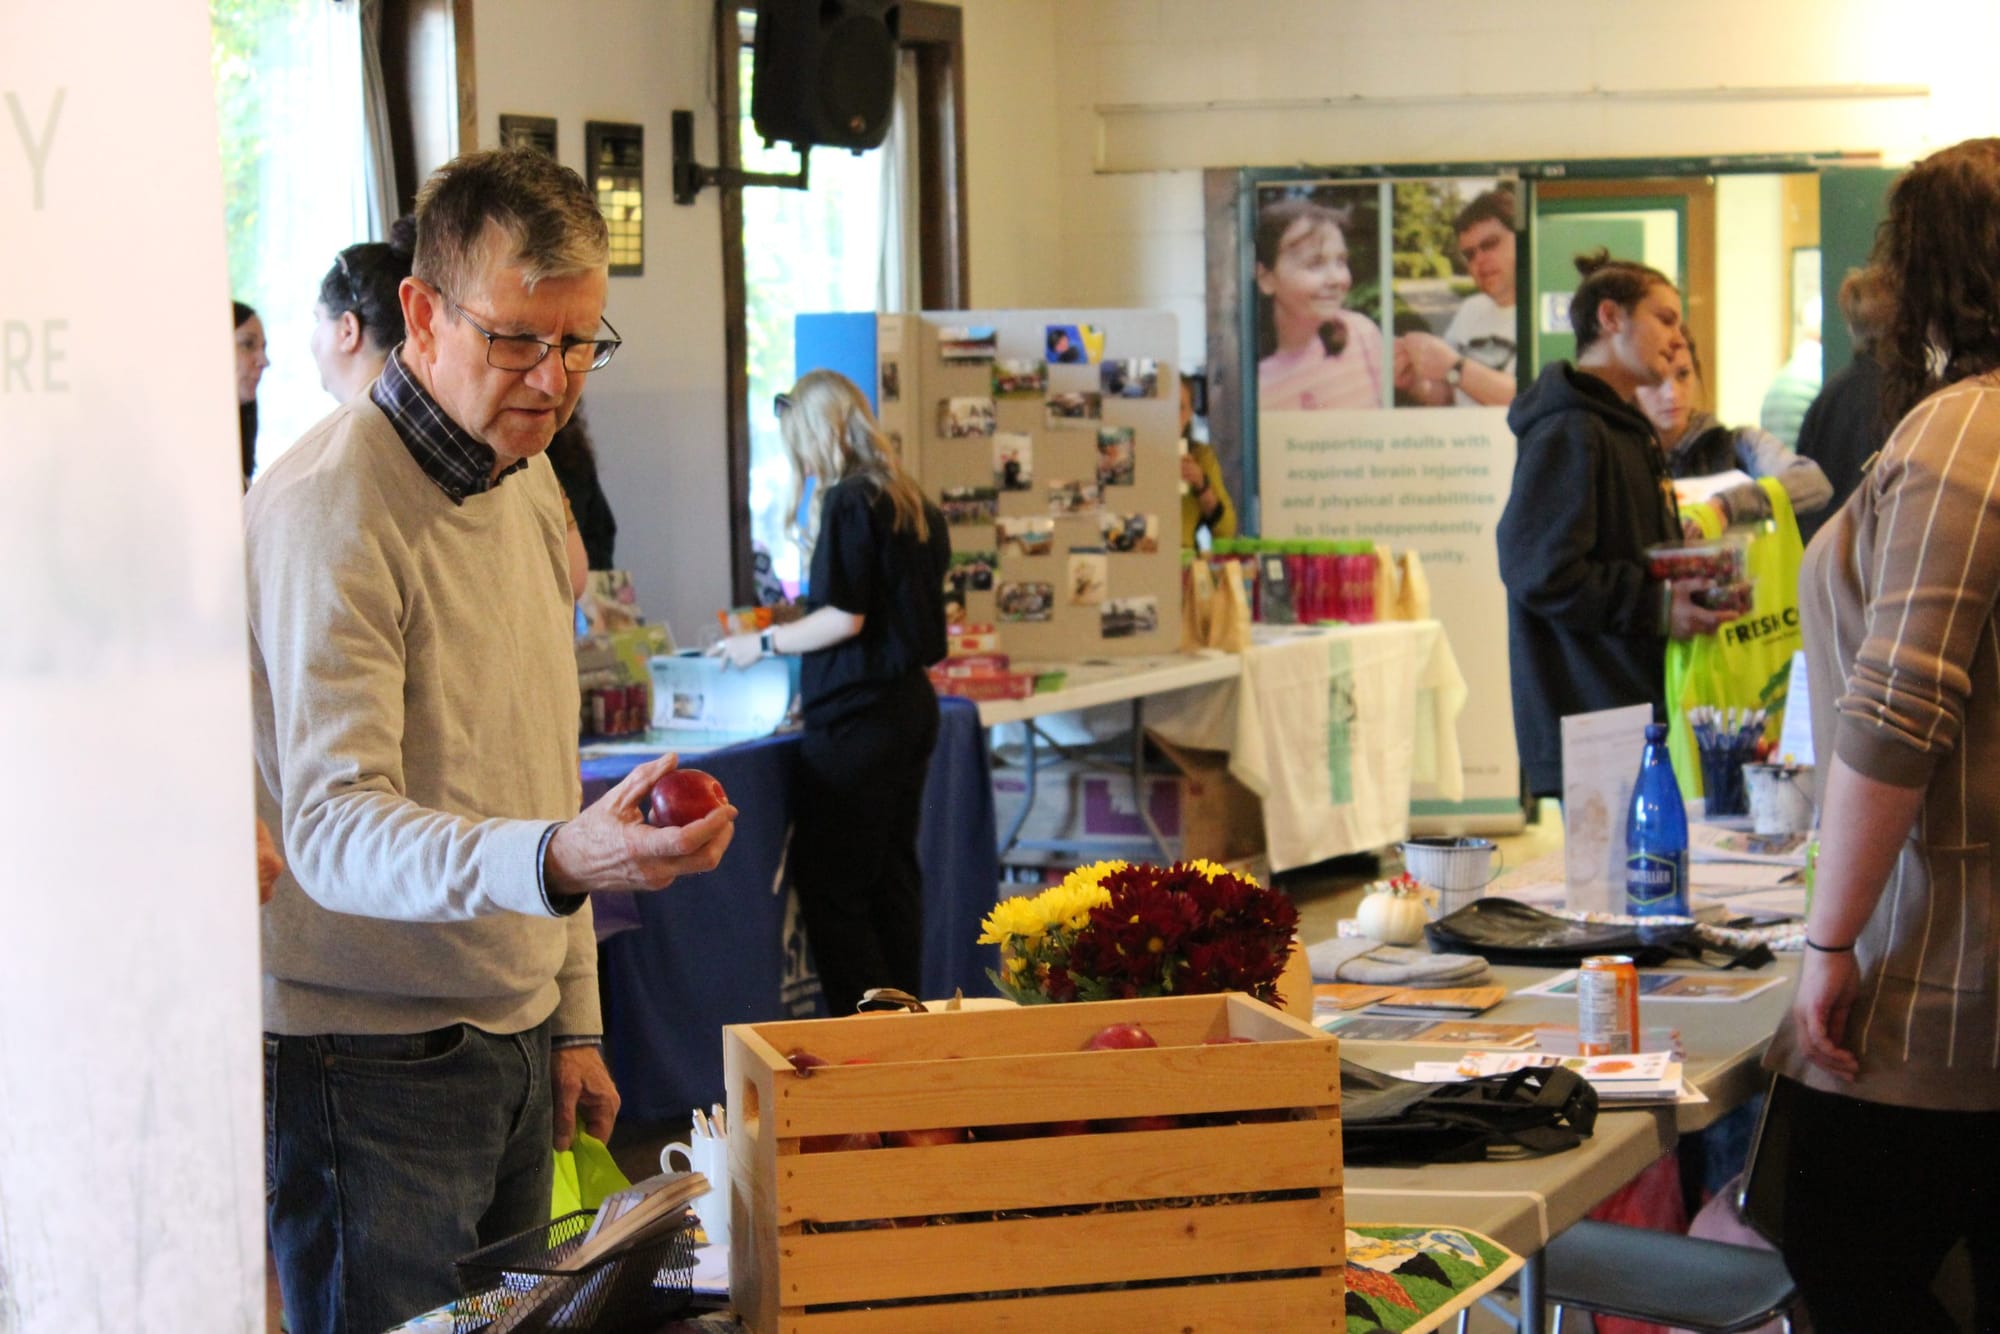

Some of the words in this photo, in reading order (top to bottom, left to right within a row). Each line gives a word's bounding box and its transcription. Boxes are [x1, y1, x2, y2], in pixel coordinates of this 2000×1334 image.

[3, 86, 68, 211] Y
[2, 317, 70, 393] RE
[1285, 436, 1385, 453] Supporting
[1391, 435, 1446, 449] adults
[1451, 434, 1491, 448] with
[1287, 465, 1364, 481] acquired
[1370, 464, 1417, 479] brain
[1422, 463, 1490, 480] injuries
[1281, 493, 1314, 508] and
[1320, 493, 1393, 510] physical
[1399, 491, 1496, 506] disabilities
[1294, 522, 1313, 536] to
[1318, 522, 1349, 535] live
[1356, 520, 1483, 538] independently
